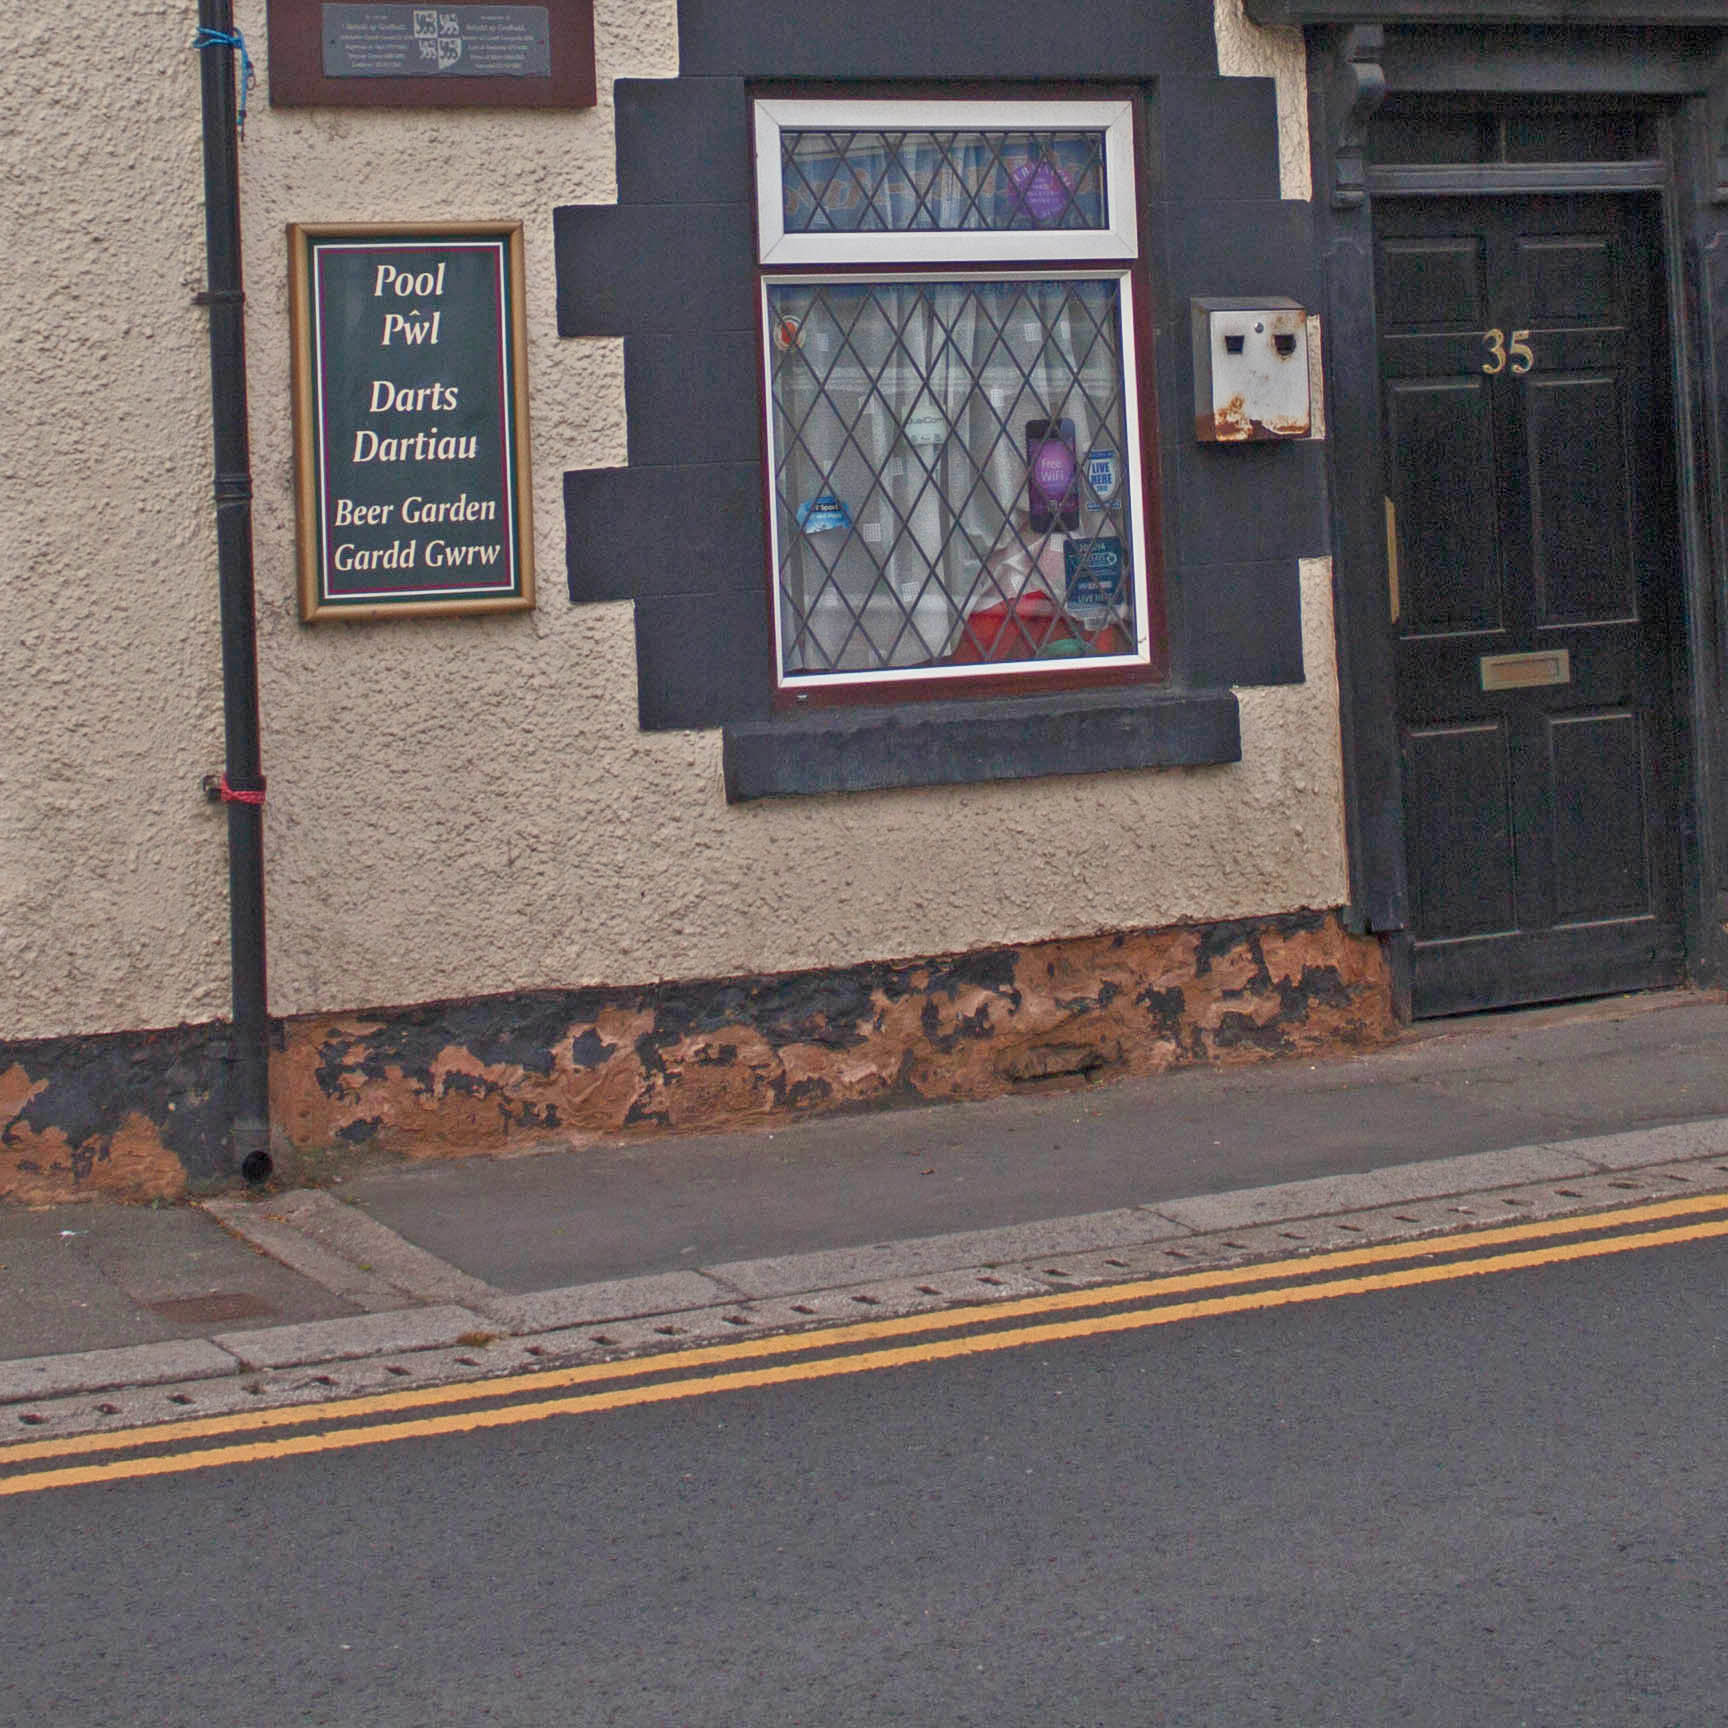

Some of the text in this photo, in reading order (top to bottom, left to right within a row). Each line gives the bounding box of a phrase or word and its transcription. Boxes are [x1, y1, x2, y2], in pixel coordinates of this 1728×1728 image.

[373, 262, 446, 298] Pool
[381, 310, 440, 346] Pŵl
[1480, 328, 1535, 374] 35
[369, 380, 459, 413] Darts
[352, 428, 478, 463] Dartiau
[1091, 462, 1109, 473] LIVE
[334, 493, 496, 527] Beer Garden
[334, 539, 500, 572] Gardd Gwrw
